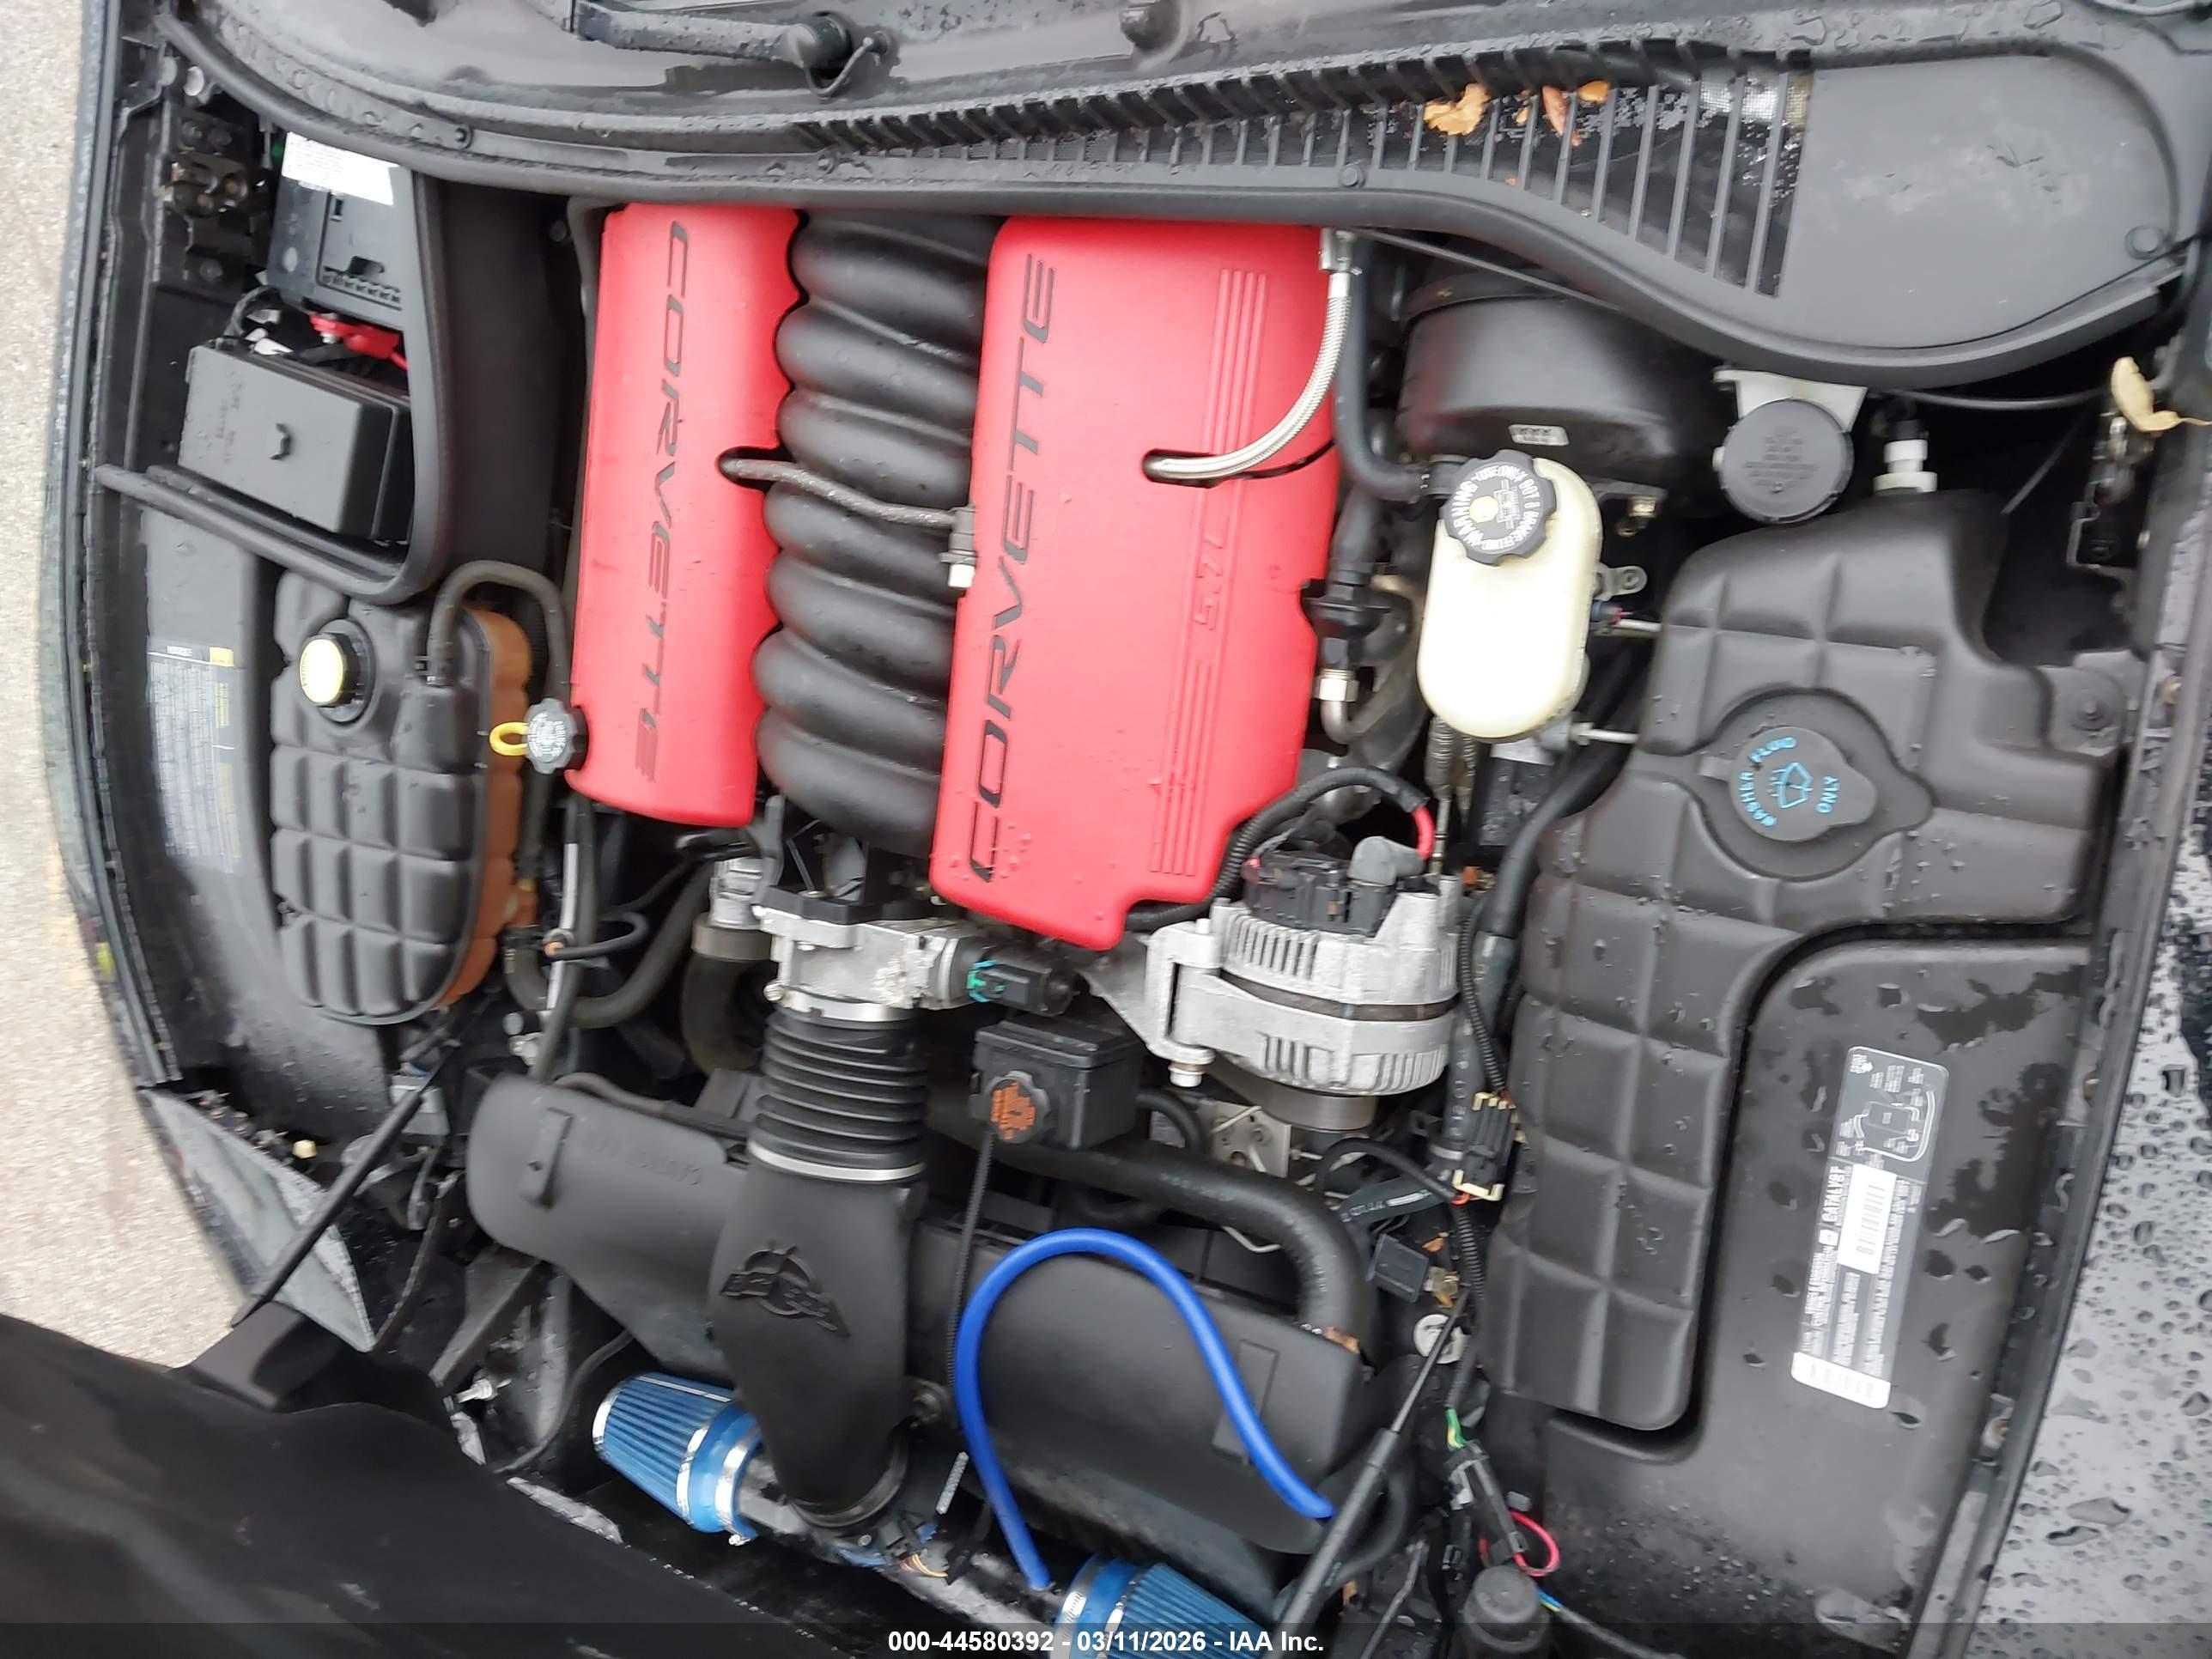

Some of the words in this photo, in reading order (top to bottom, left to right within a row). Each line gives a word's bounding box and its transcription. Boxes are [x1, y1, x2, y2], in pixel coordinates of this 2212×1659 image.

[635, 221, 689, 782] CORVETTE
[969, 253, 1054, 883] CORVETTE
[1815, 775, 1839, 814] ONLY
